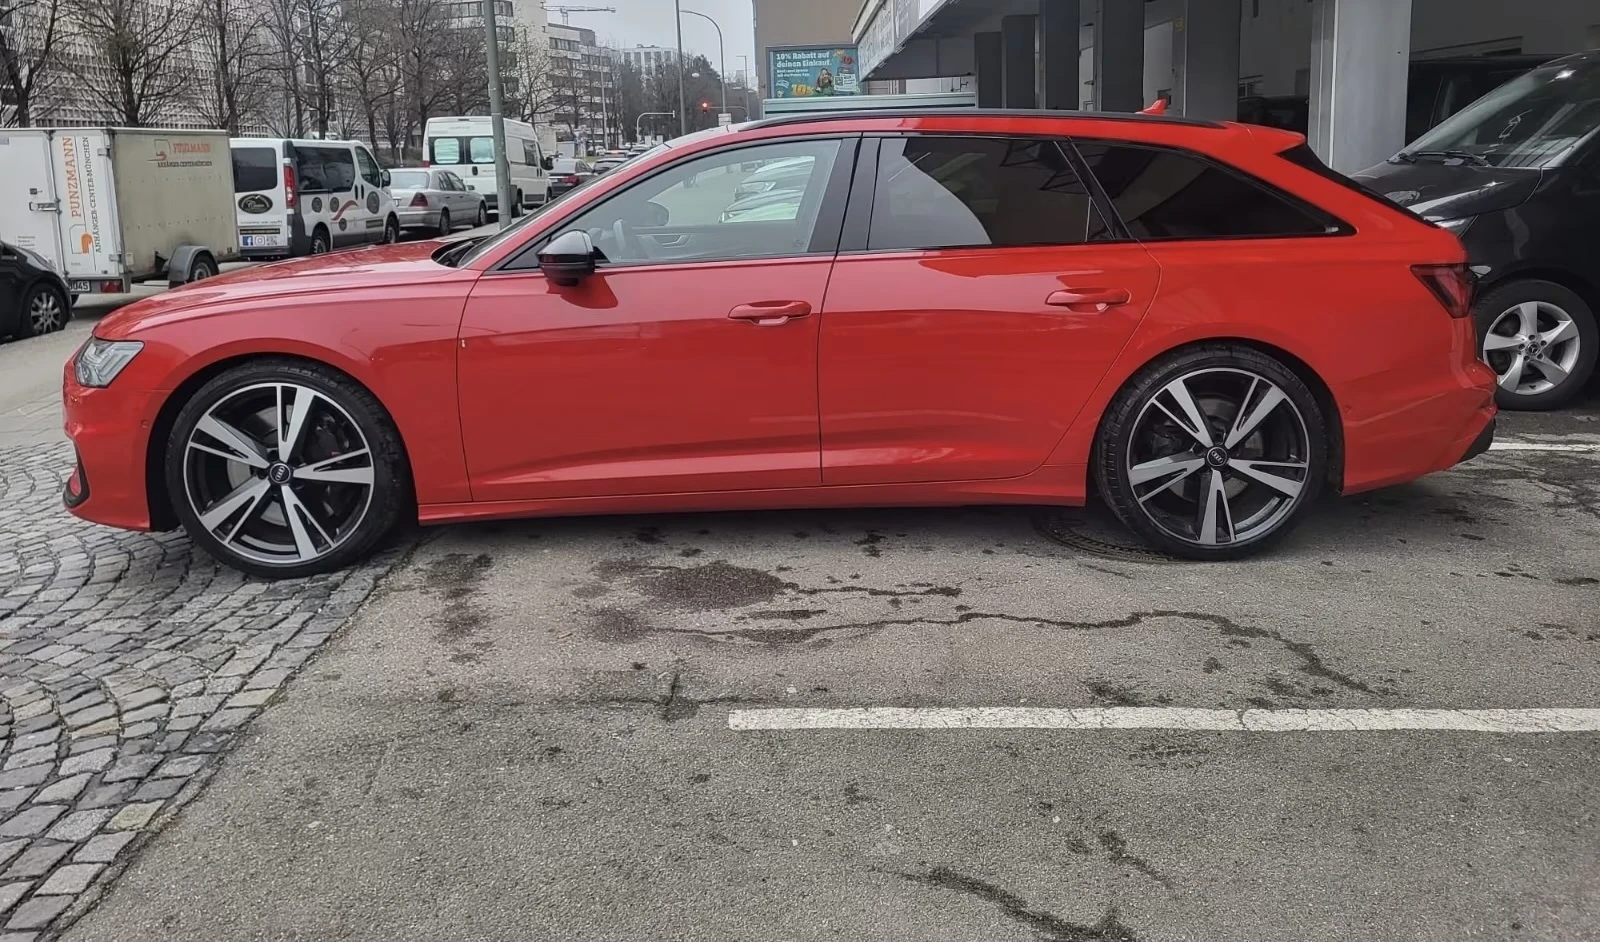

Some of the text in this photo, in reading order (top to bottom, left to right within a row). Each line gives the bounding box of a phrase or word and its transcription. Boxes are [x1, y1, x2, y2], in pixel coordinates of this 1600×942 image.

[817, 51, 830, 59] auf
[776, 59, 832, 68] deinen Einkauf.
[62, 137, 81, 217] PUNZMANN
